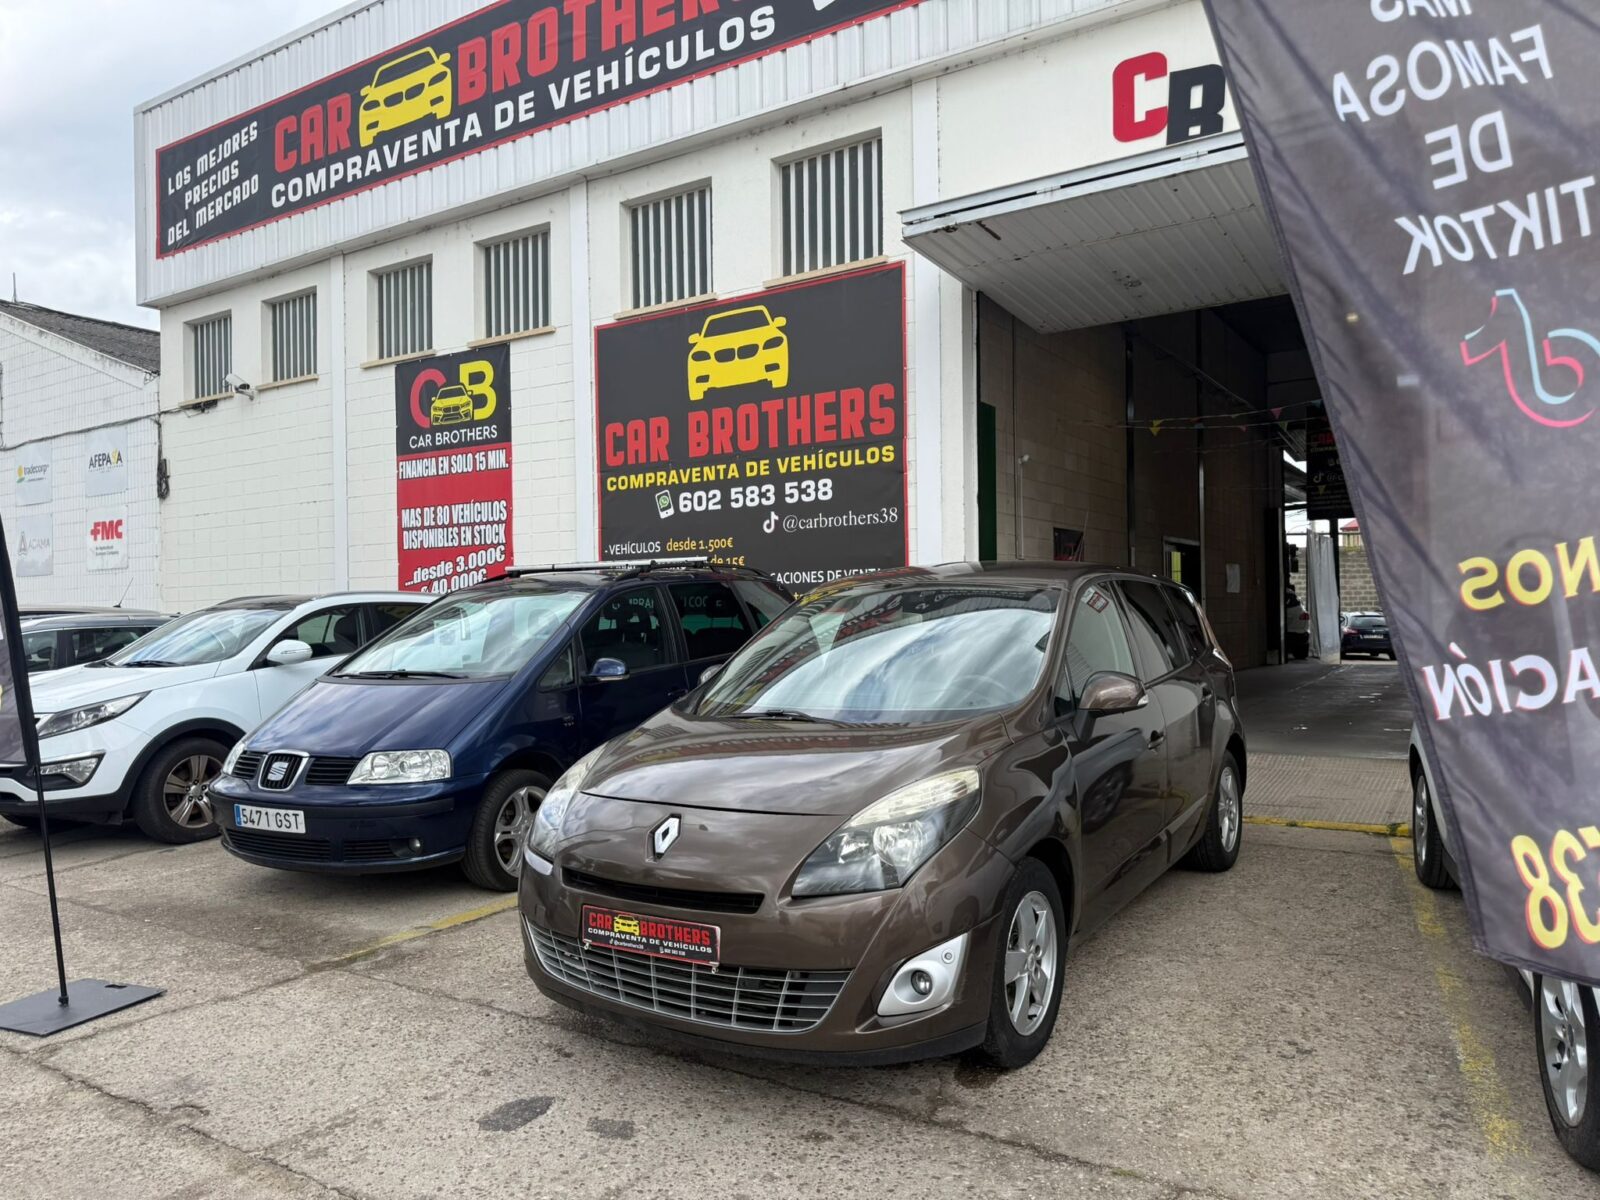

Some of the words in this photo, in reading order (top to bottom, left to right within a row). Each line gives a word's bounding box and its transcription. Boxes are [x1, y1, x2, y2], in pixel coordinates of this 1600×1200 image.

[271, 117, 483, 209] COMPRAVENTA
[493, 90, 536, 132] DE
[547, 5, 776, 110] VEHÍCULOS
[274, 92, 352, 174] CAR
[167, 165, 192, 196] LOS
[197, 121, 258, 177] MEJORES
[184, 160, 239, 210] PRECIOS
[167, 218, 190, 246] DEL
[195, 174, 259, 229] MERCADO
[409, 431, 432, 449] CAR
[436, 424, 498, 446] BROTHERS
[604, 416, 669, 467] CAR
[688, 383, 895, 459] BROTHERS
[399, 457, 437, 480] FINANCIA
[438, 456, 449, 475] EN
[451, 453, 473, 474] SOLO
[475, 451, 486, 472] 15
[487, 448, 509, 470] MIN.
[606, 463, 739, 491] COMPRAVENTA
[746, 459, 770, 477] DE
[776, 445, 895, 475] VEHÍCULOS
[678, 489, 721, 513] 602
[730, 483, 776, 508] 583
[784, 478, 833, 504] 538
[401, 508, 421, 529] MAS
[423, 506, 435, 527] DE
[436, 505, 450, 526] 80
[451, 499, 507, 524] VEHÍCULOS
[782, 507, 899, 533] @carbrothers38
[91, 519, 123, 541] FMC
[403, 527, 458, 550] DISPONIBLES
[460, 526, 472, 546] EN
[473, 523, 506, 546] STOCK
[666, 537, 697, 552] desde
[698, 537, 734, 552] 1.500€
[455, 545, 506, 573] 3.000€
[770, 571, 824, 585] ACIONES
[241, 808, 270, 828] 5471
[274, 812, 300, 830] GST
[588, 912, 612, 930] CAR
[640, 920, 711, 945] BROTHERS
[588, 927, 647, 943] COMPRAVENTA
[649, 938, 660, 946] DE
[662, 940, 713, 953] VEHÍCULOS
